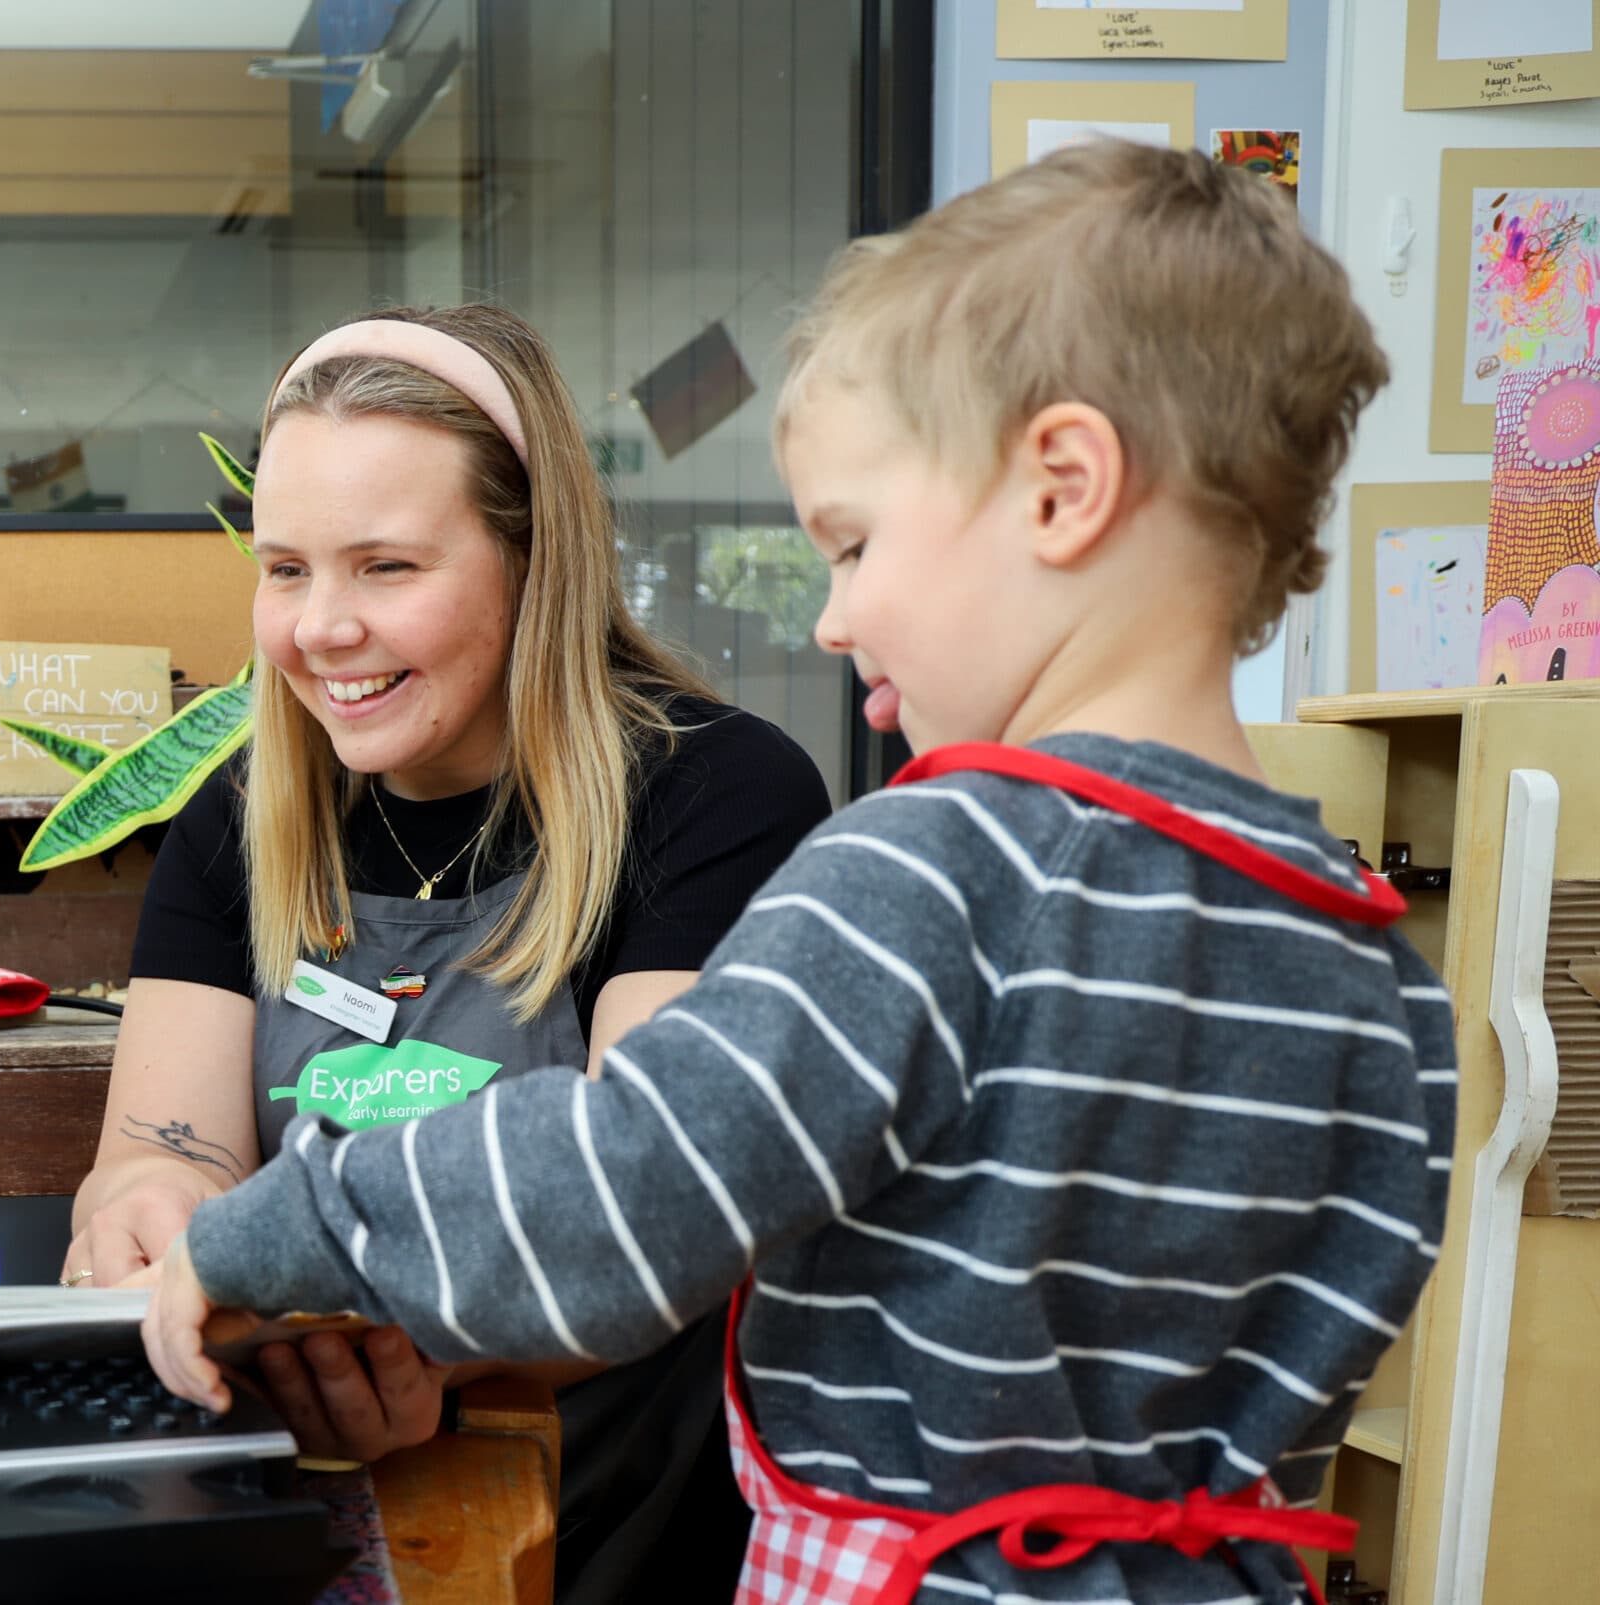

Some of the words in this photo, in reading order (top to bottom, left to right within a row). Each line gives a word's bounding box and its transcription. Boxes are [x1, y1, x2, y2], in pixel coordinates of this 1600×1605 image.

[1562, 601, 1578, 617] BY
[1507, 625, 1551, 650] MELISSA
[23, 688, 86, 716] CAN
[100, 689, 159, 715] YOU
[343, 992, 377, 1014] Naomi
[382, 1103, 436, 1119] Learnin
